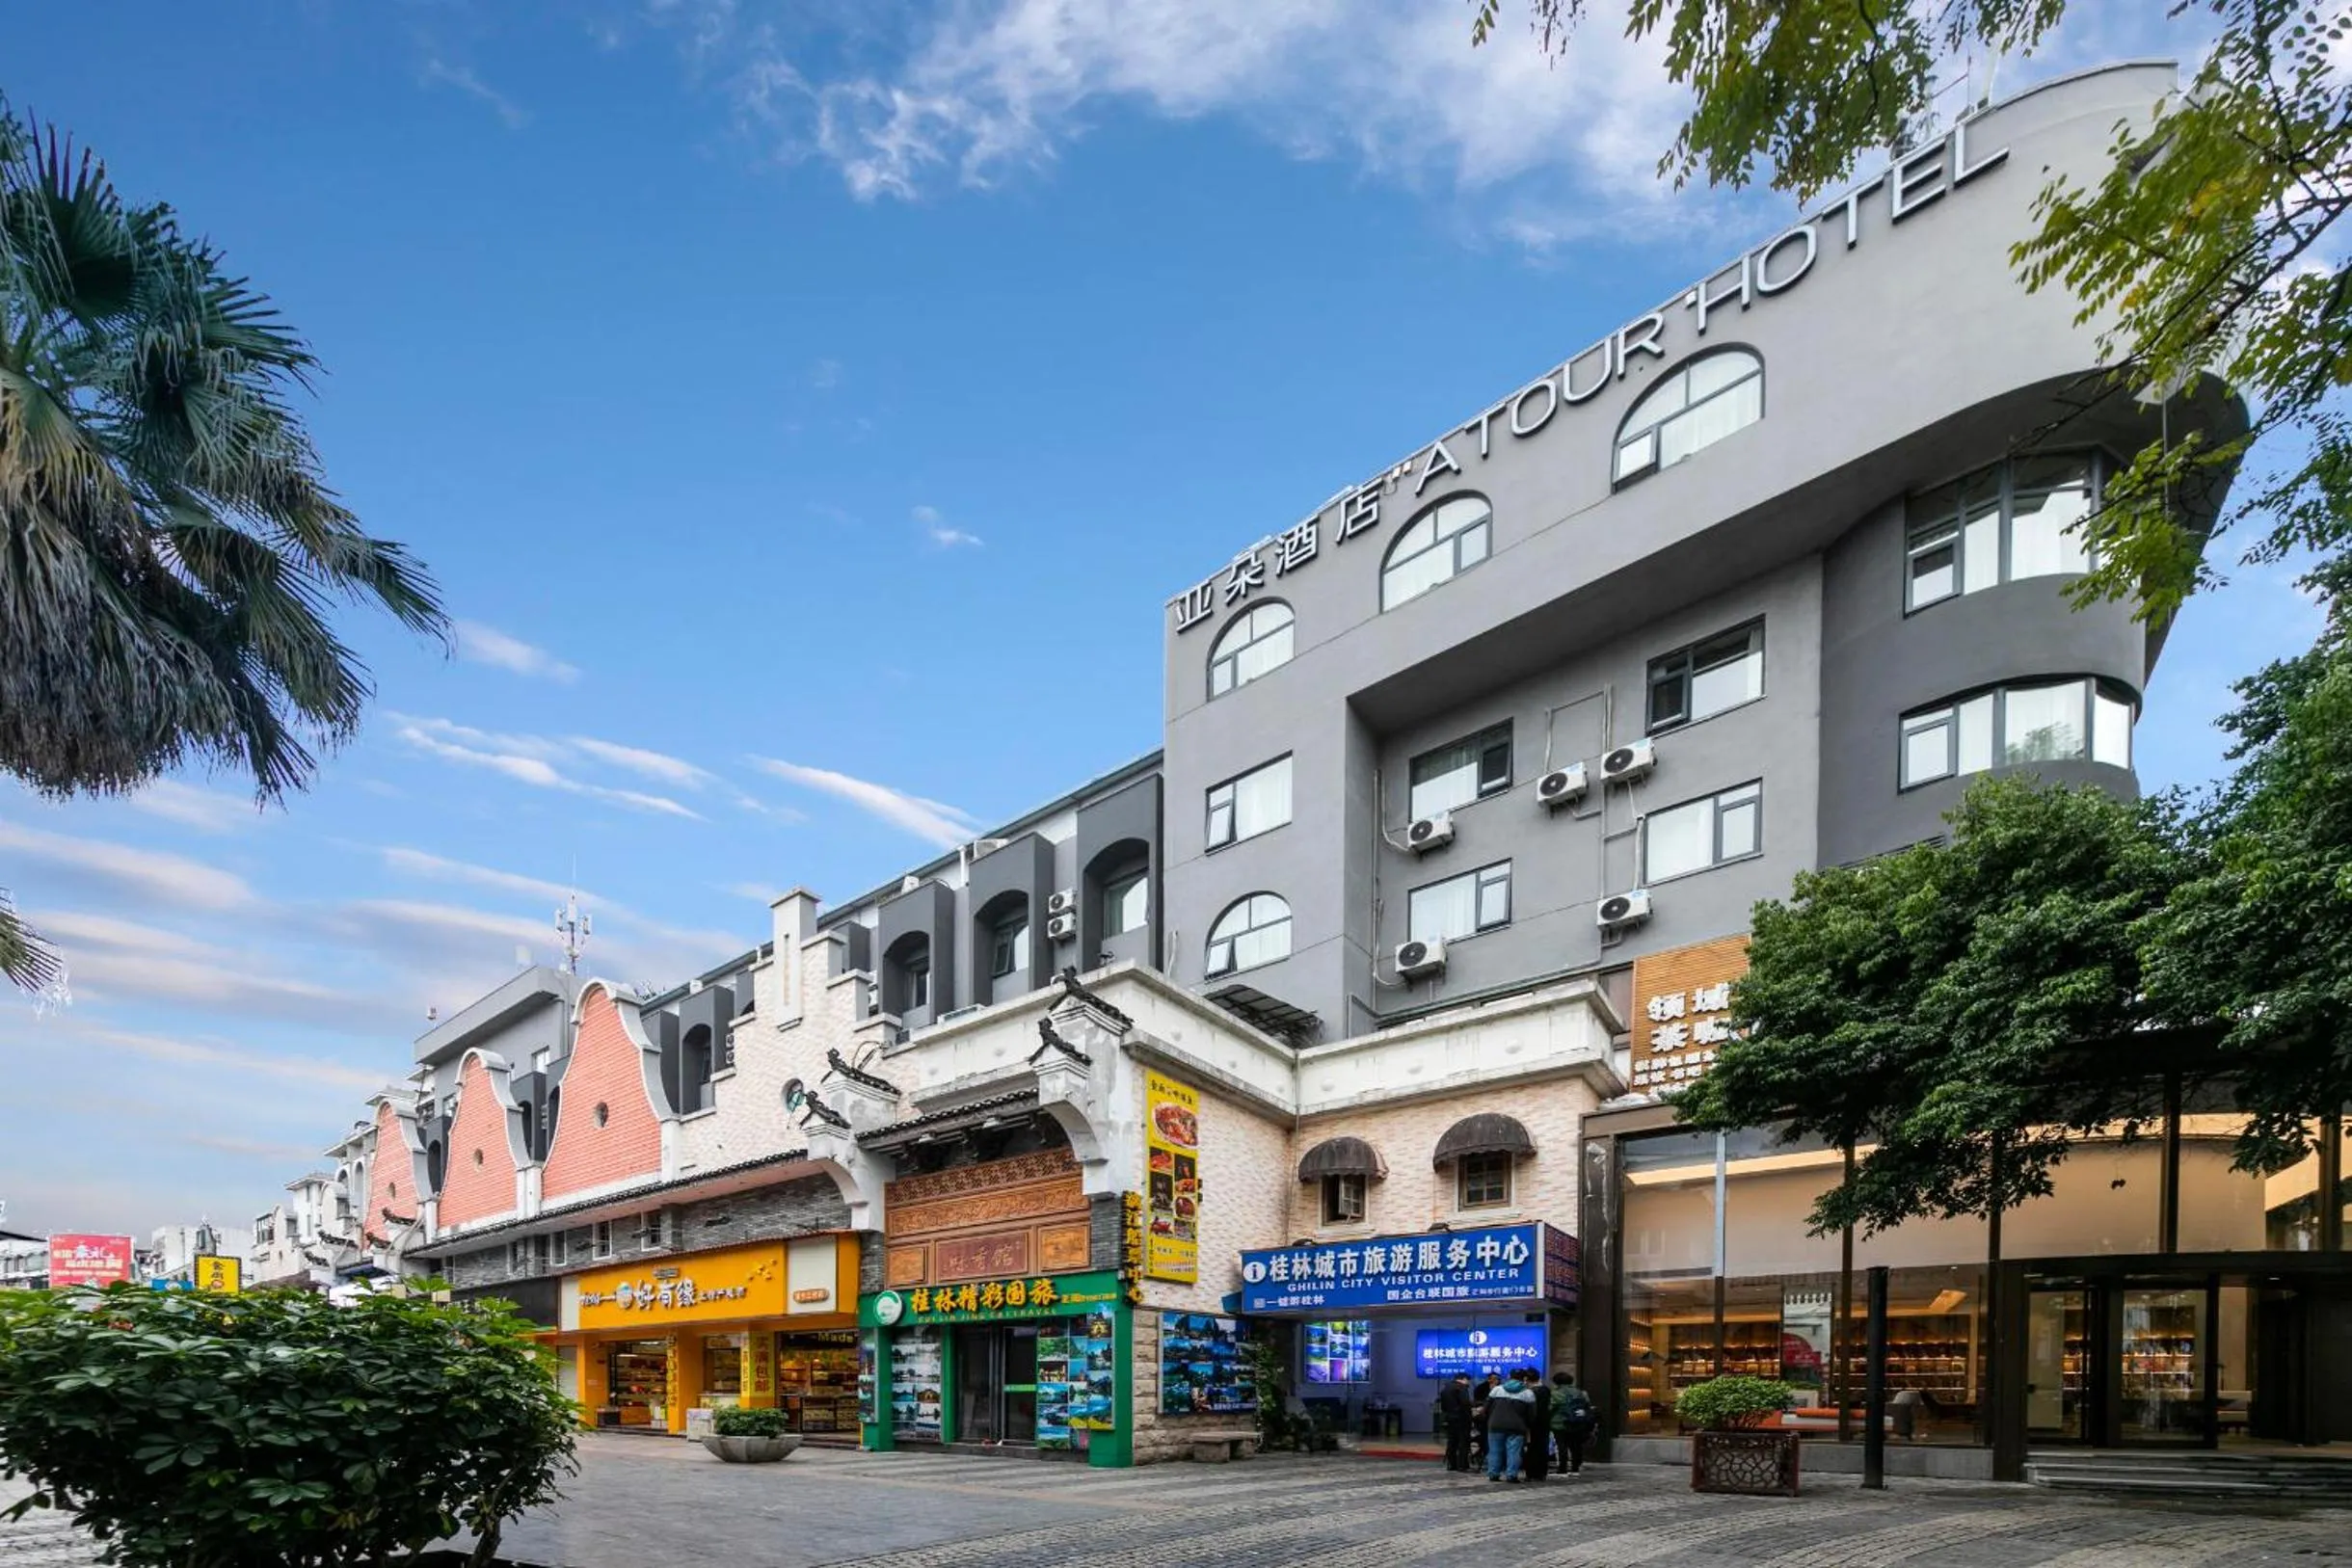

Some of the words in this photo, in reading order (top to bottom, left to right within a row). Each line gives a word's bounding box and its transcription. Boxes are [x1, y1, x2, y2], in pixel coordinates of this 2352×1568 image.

[1414, 311, 1665, 497] ATOUR
[1697, 121, 2010, 335] HOTEL
[1175, 478, 1382, 633] 亚朵酒店
[1269, 1234, 1530, 1283] 桂林城市旅游服务中心
[1341, 1278, 1374, 1289] CITY
[1380, 1272, 1445, 1286] VISITOR
[1452, 1267, 1519, 1281] CENTER
[911, 1278, 1056, 1315] 桂林精彩国旅
